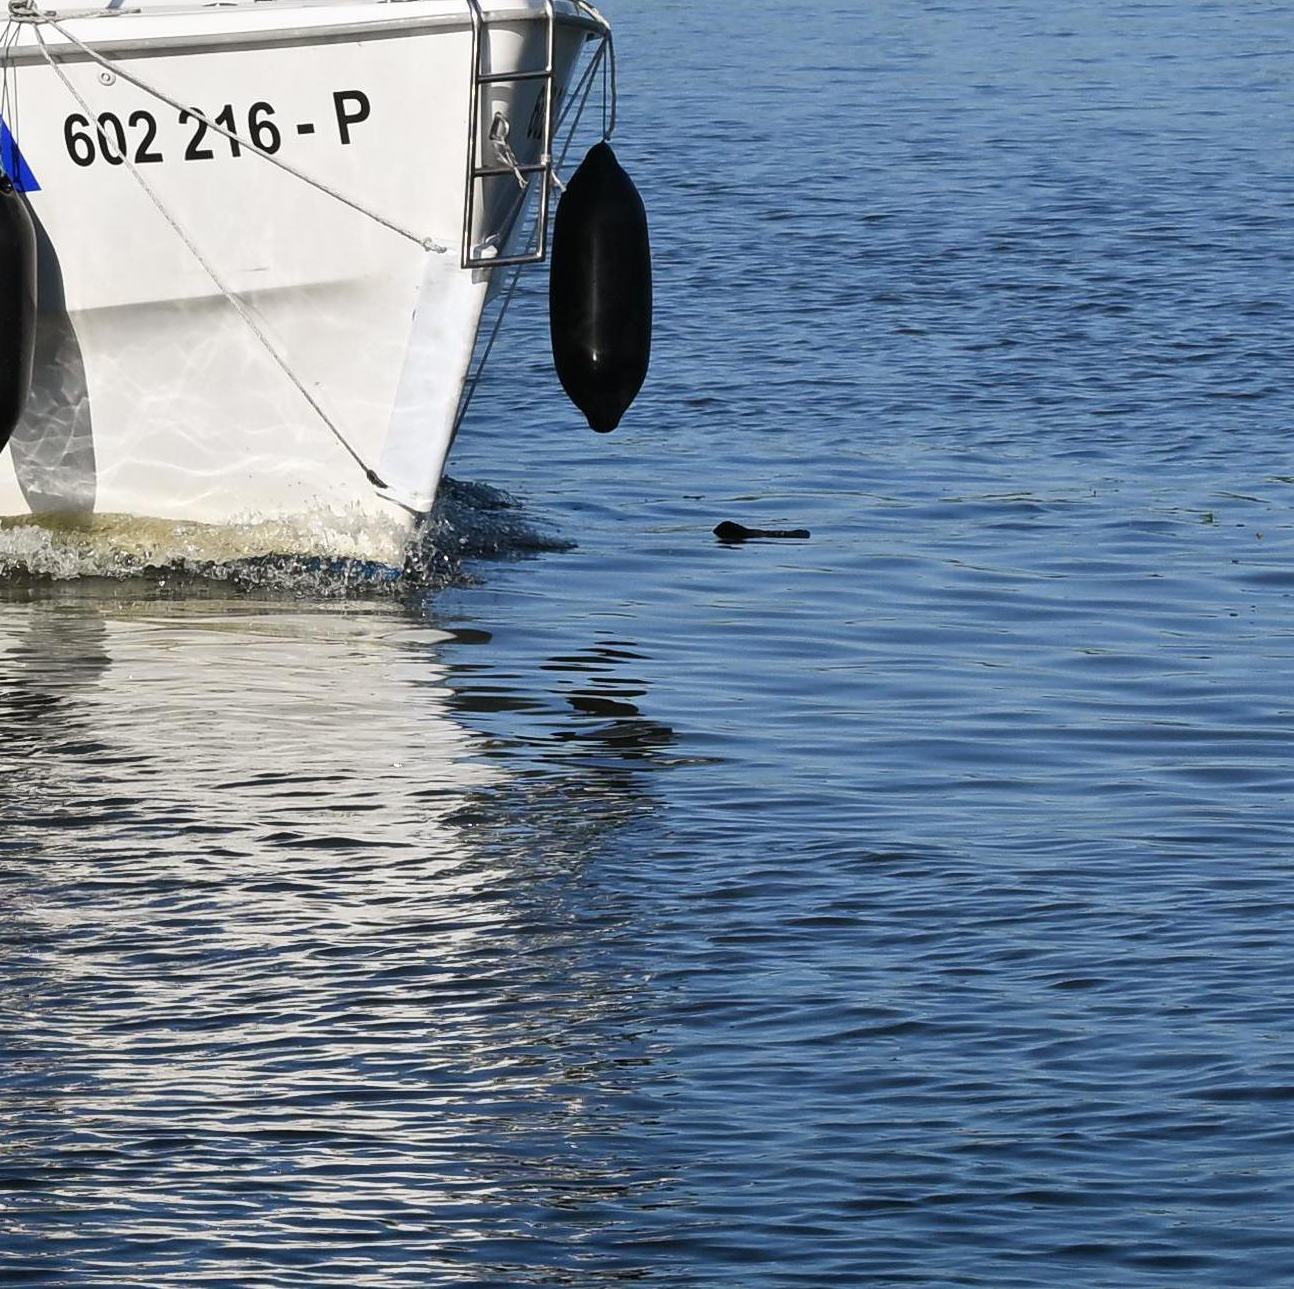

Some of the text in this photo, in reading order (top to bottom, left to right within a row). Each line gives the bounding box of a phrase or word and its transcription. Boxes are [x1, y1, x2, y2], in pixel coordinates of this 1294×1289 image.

[64, 111, 164, 168] 602
[184, 101, 282, 161] 216
[333, 90, 372, 145] P
